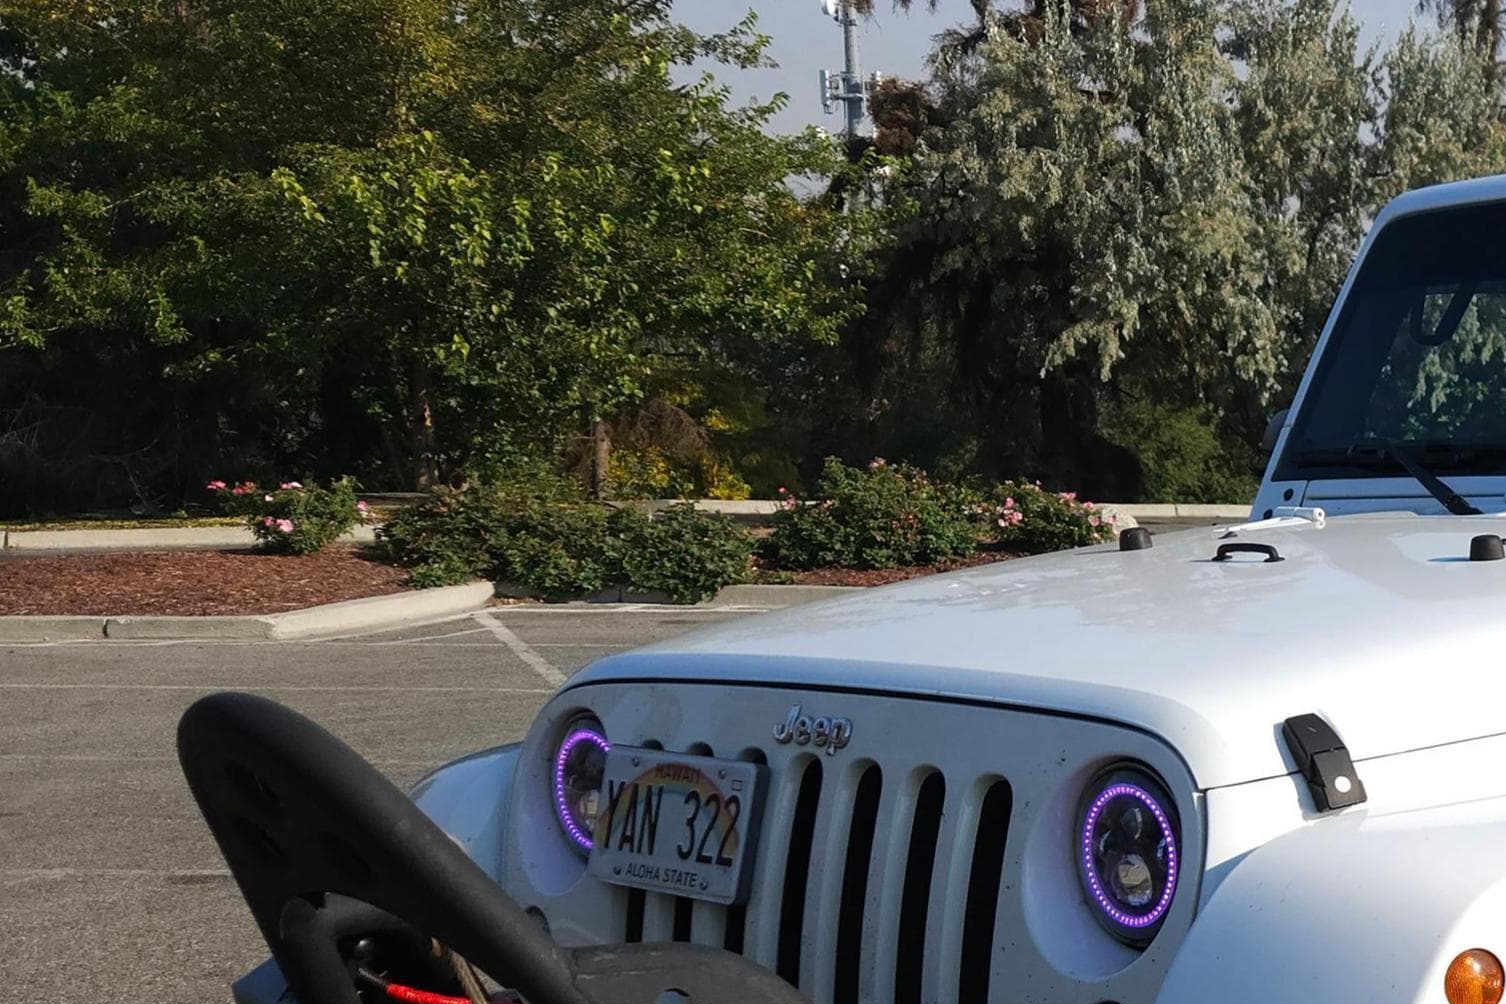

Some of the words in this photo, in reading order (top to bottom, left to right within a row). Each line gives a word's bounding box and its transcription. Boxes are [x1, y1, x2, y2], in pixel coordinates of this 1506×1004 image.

[773, 704, 852, 756] Jeep
[604, 779, 664, 855] YAN
[676, 790, 741, 868] 322
[625, 862, 660, 881] ALOHA
[662, 868, 698, 887] STATE
